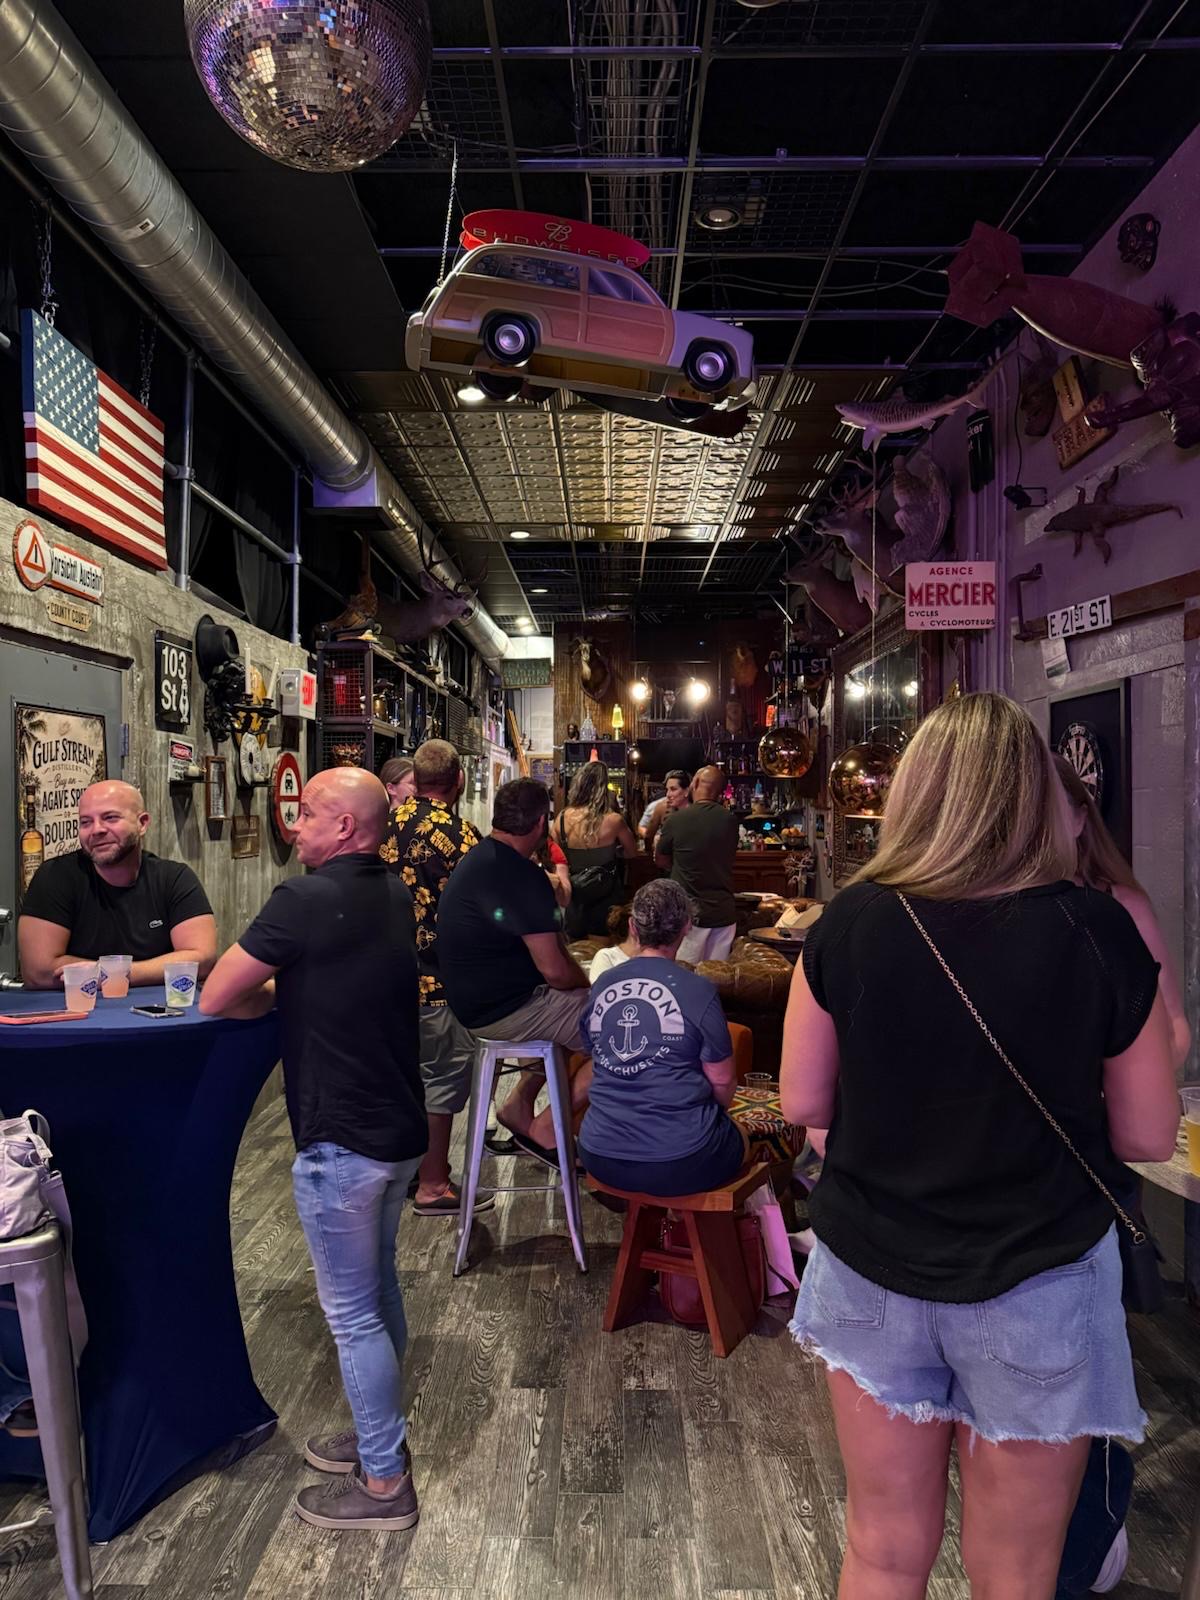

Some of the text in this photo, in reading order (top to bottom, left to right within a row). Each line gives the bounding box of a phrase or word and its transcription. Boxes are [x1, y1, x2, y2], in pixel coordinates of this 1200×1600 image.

[472, 227, 639, 265] BUDWEISER
[929, 567, 974, 575] AGENCE
[908, 582, 995, 607] MERCIER
[51, 602, 88, 625] COUNTY COURT
[908, 610, 939, 618] CYCLES
[930, 618, 995, 627] CYCLOMOTEURS
[1090, 599, 1110, 627] ST.
[161, 645, 187, 680] 103
[811, 657, 828, 673] ST
[161, 679, 178, 711] St
[33, 738, 95, 769] GULF STREAM
[52, 764, 82, 772] DISTILLERY
[42, 788, 68, 812] AGAVE
[594, 982, 677, 1018] BOSTON
